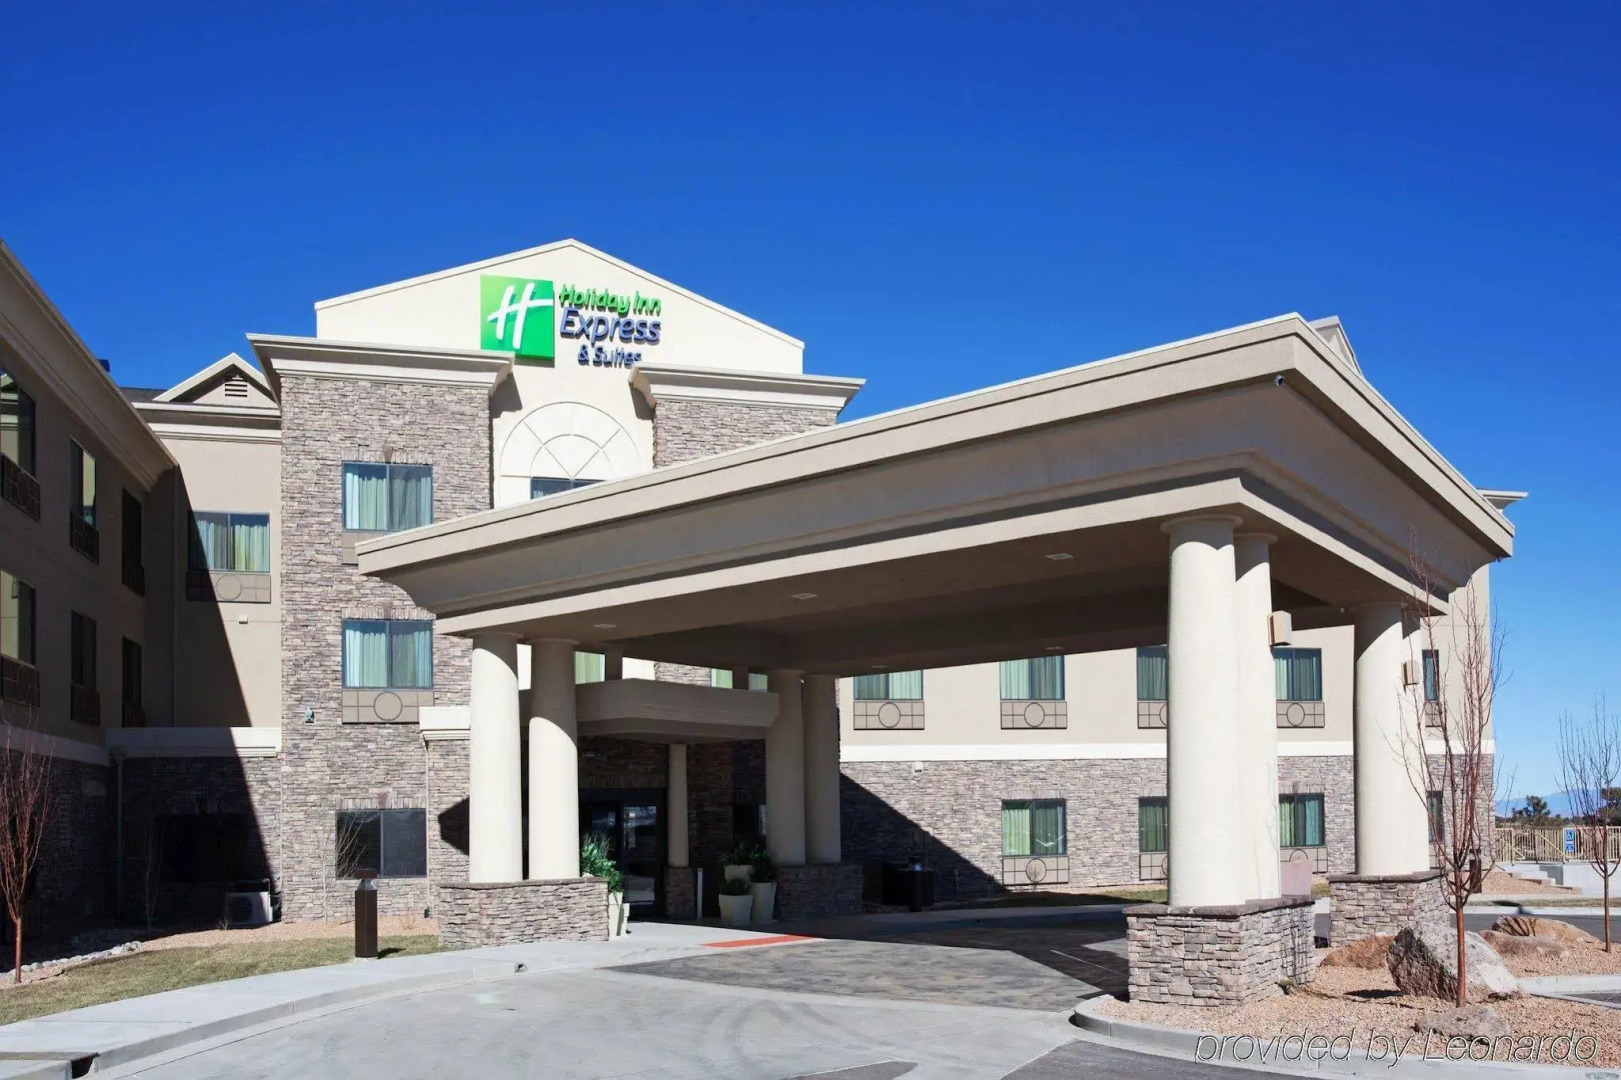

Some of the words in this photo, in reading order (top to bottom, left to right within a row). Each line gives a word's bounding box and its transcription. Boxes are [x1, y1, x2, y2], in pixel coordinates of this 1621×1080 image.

[559, 284, 630, 317] Holiday
[633, 290, 661, 316] Inn
[560, 307, 661, 347] Express
[578, 344, 589, 366] &
[593, 346, 642, 368] Suites
